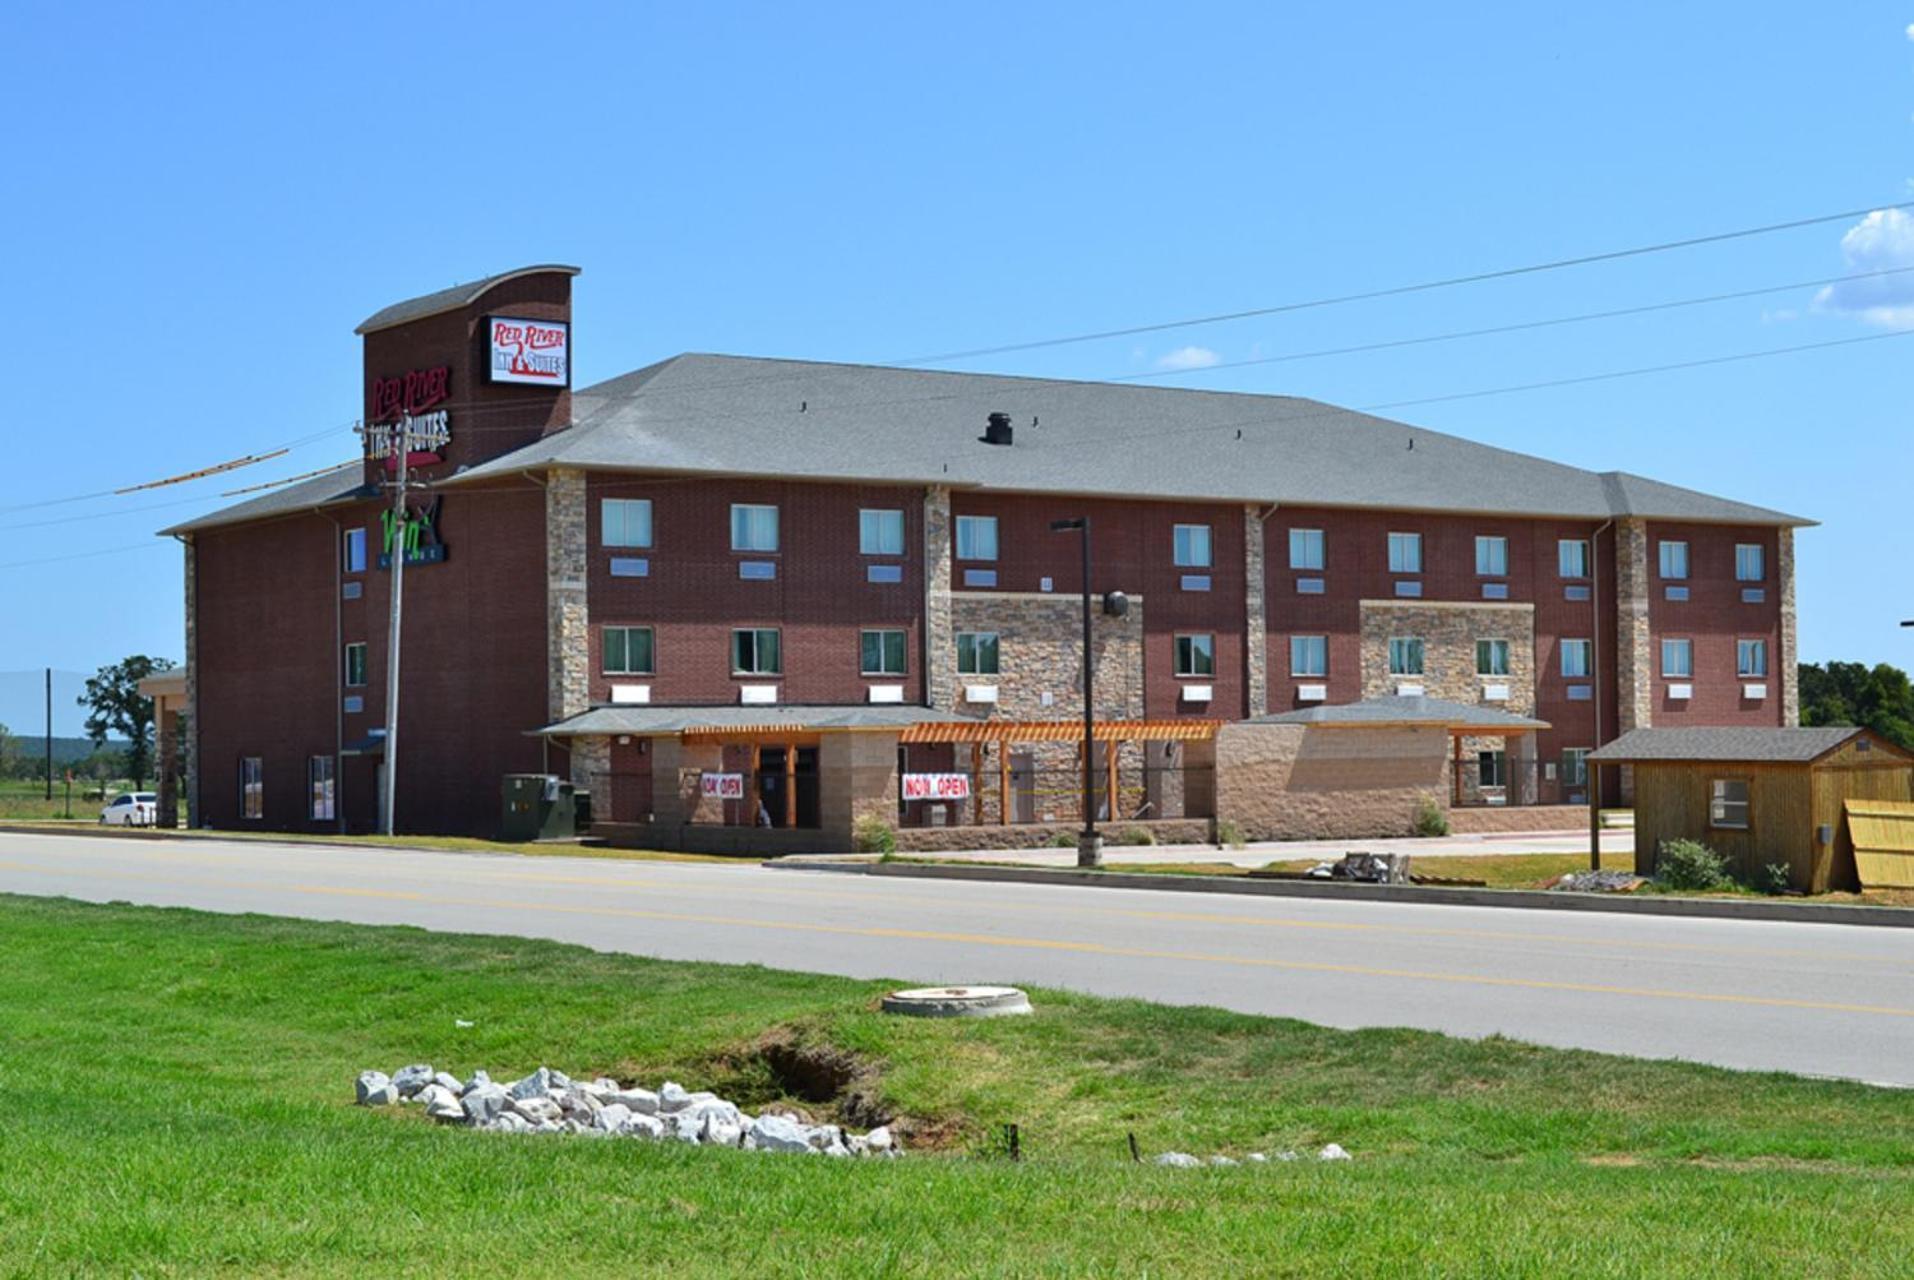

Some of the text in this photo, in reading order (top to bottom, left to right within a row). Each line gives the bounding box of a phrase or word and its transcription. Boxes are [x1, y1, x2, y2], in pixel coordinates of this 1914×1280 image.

[494, 323, 564, 349] RED RIVER
[373, 367, 449, 420] RED RIVER
[906, 777, 967, 796] NOW OPEN
